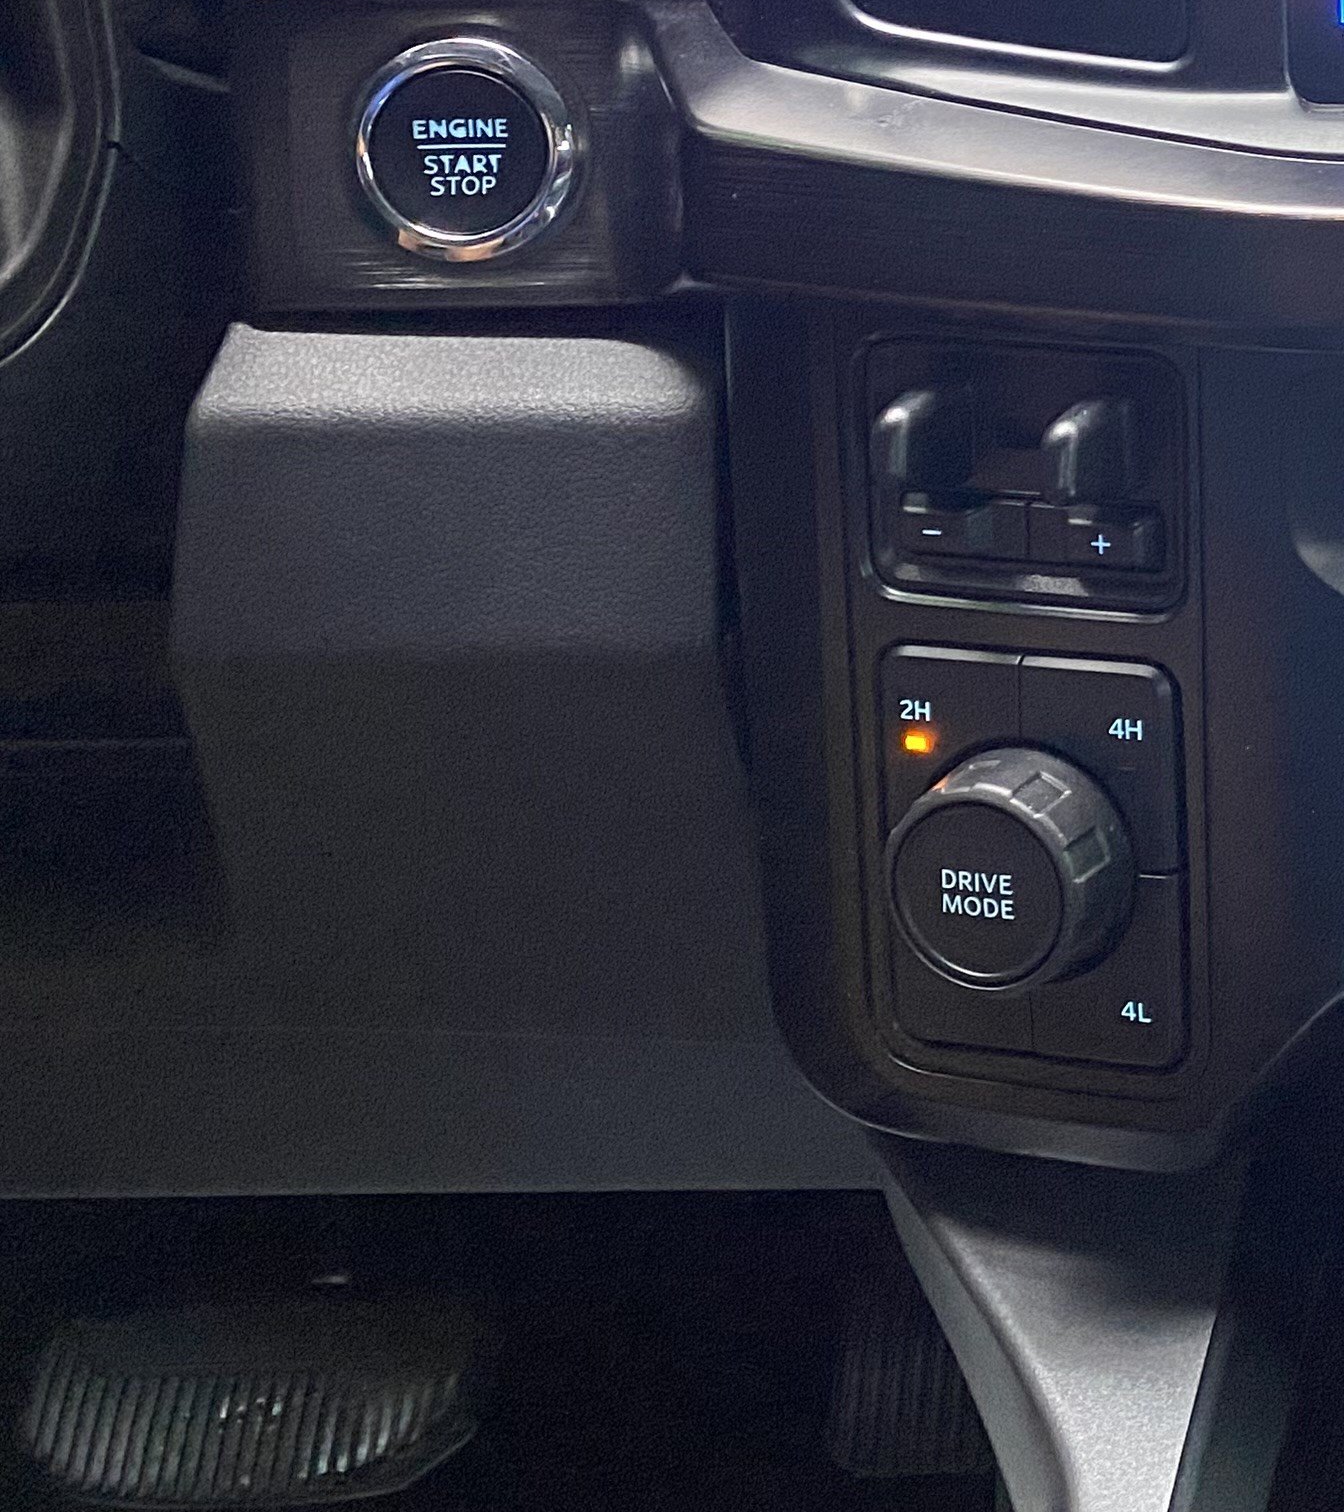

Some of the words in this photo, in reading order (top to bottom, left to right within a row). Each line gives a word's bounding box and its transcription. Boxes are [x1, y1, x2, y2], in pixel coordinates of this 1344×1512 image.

[412, 118, 509, 140] ENGINE
[423, 154, 502, 175] START
[430, 175, 497, 196] STOP
[899, 699, 931, 722] 2H
[1108, 718, 1143, 741] 4H
[941, 868, 1014, 896] DRIVE
[942, 892, 1015, 920] MODE
[1120, 1001, 1152, 1024] 4L
